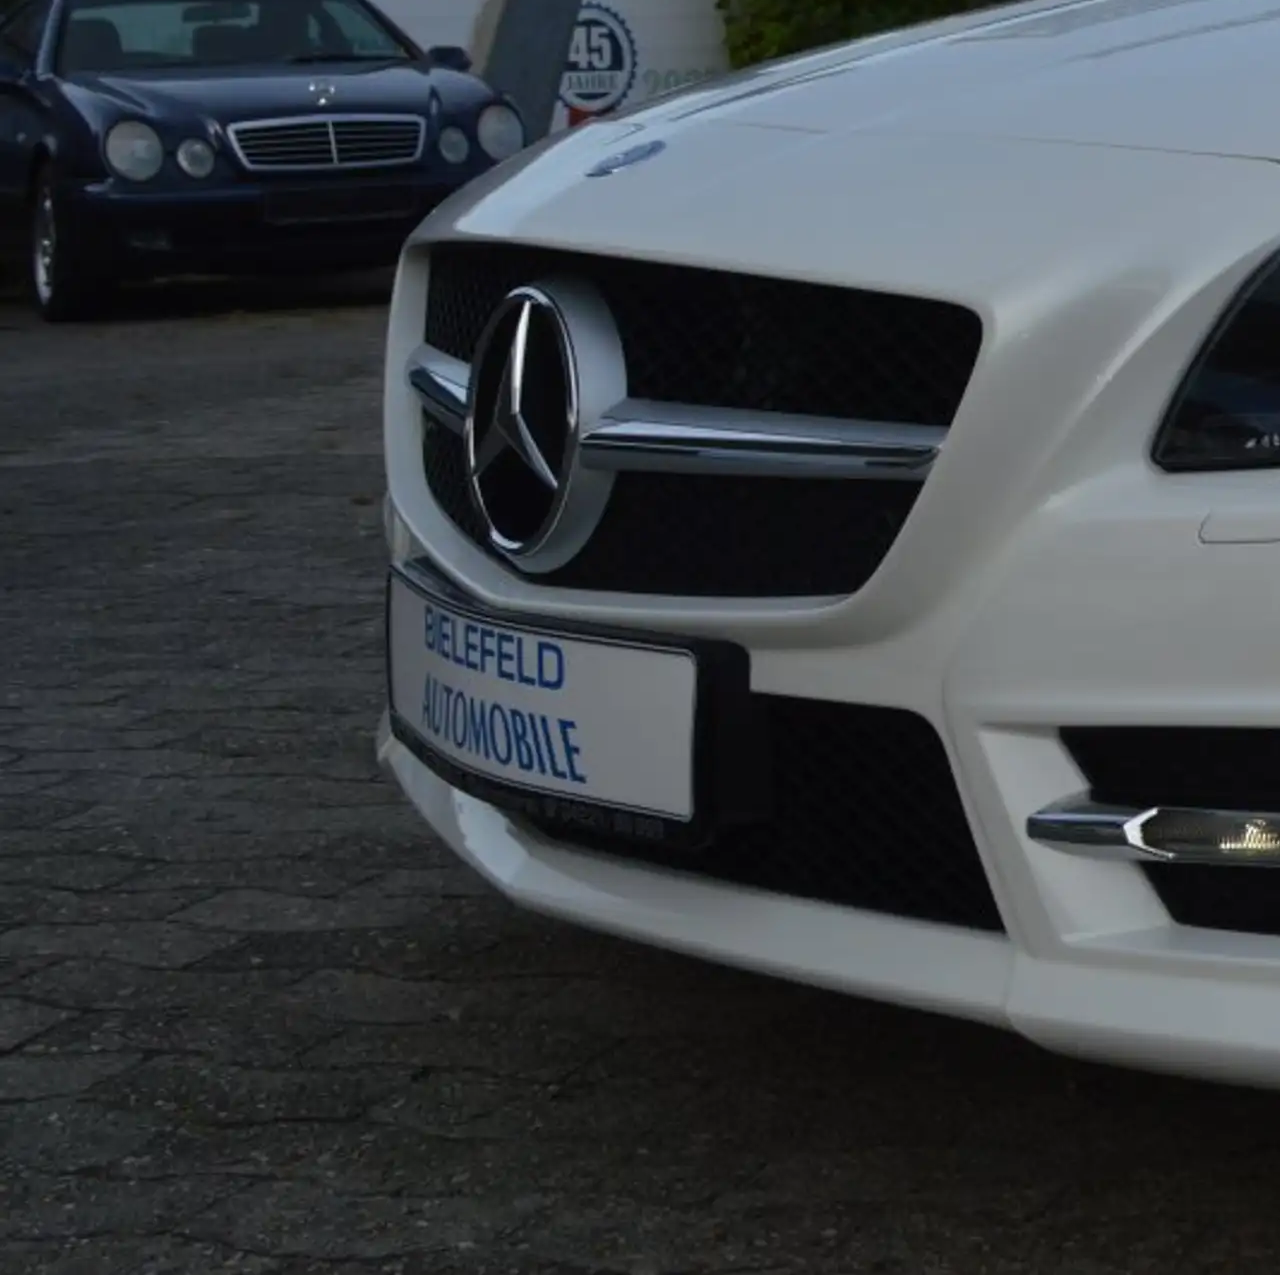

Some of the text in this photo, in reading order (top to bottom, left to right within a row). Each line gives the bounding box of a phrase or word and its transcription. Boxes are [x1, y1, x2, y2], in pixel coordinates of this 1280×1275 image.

[567, 25, 612, 70] 45
[567, 71, 618, 91] JAHRE
[424, 604, 565, 690] BIELEFELD
[422, 672, 586, 784] AUTOMOBILE
